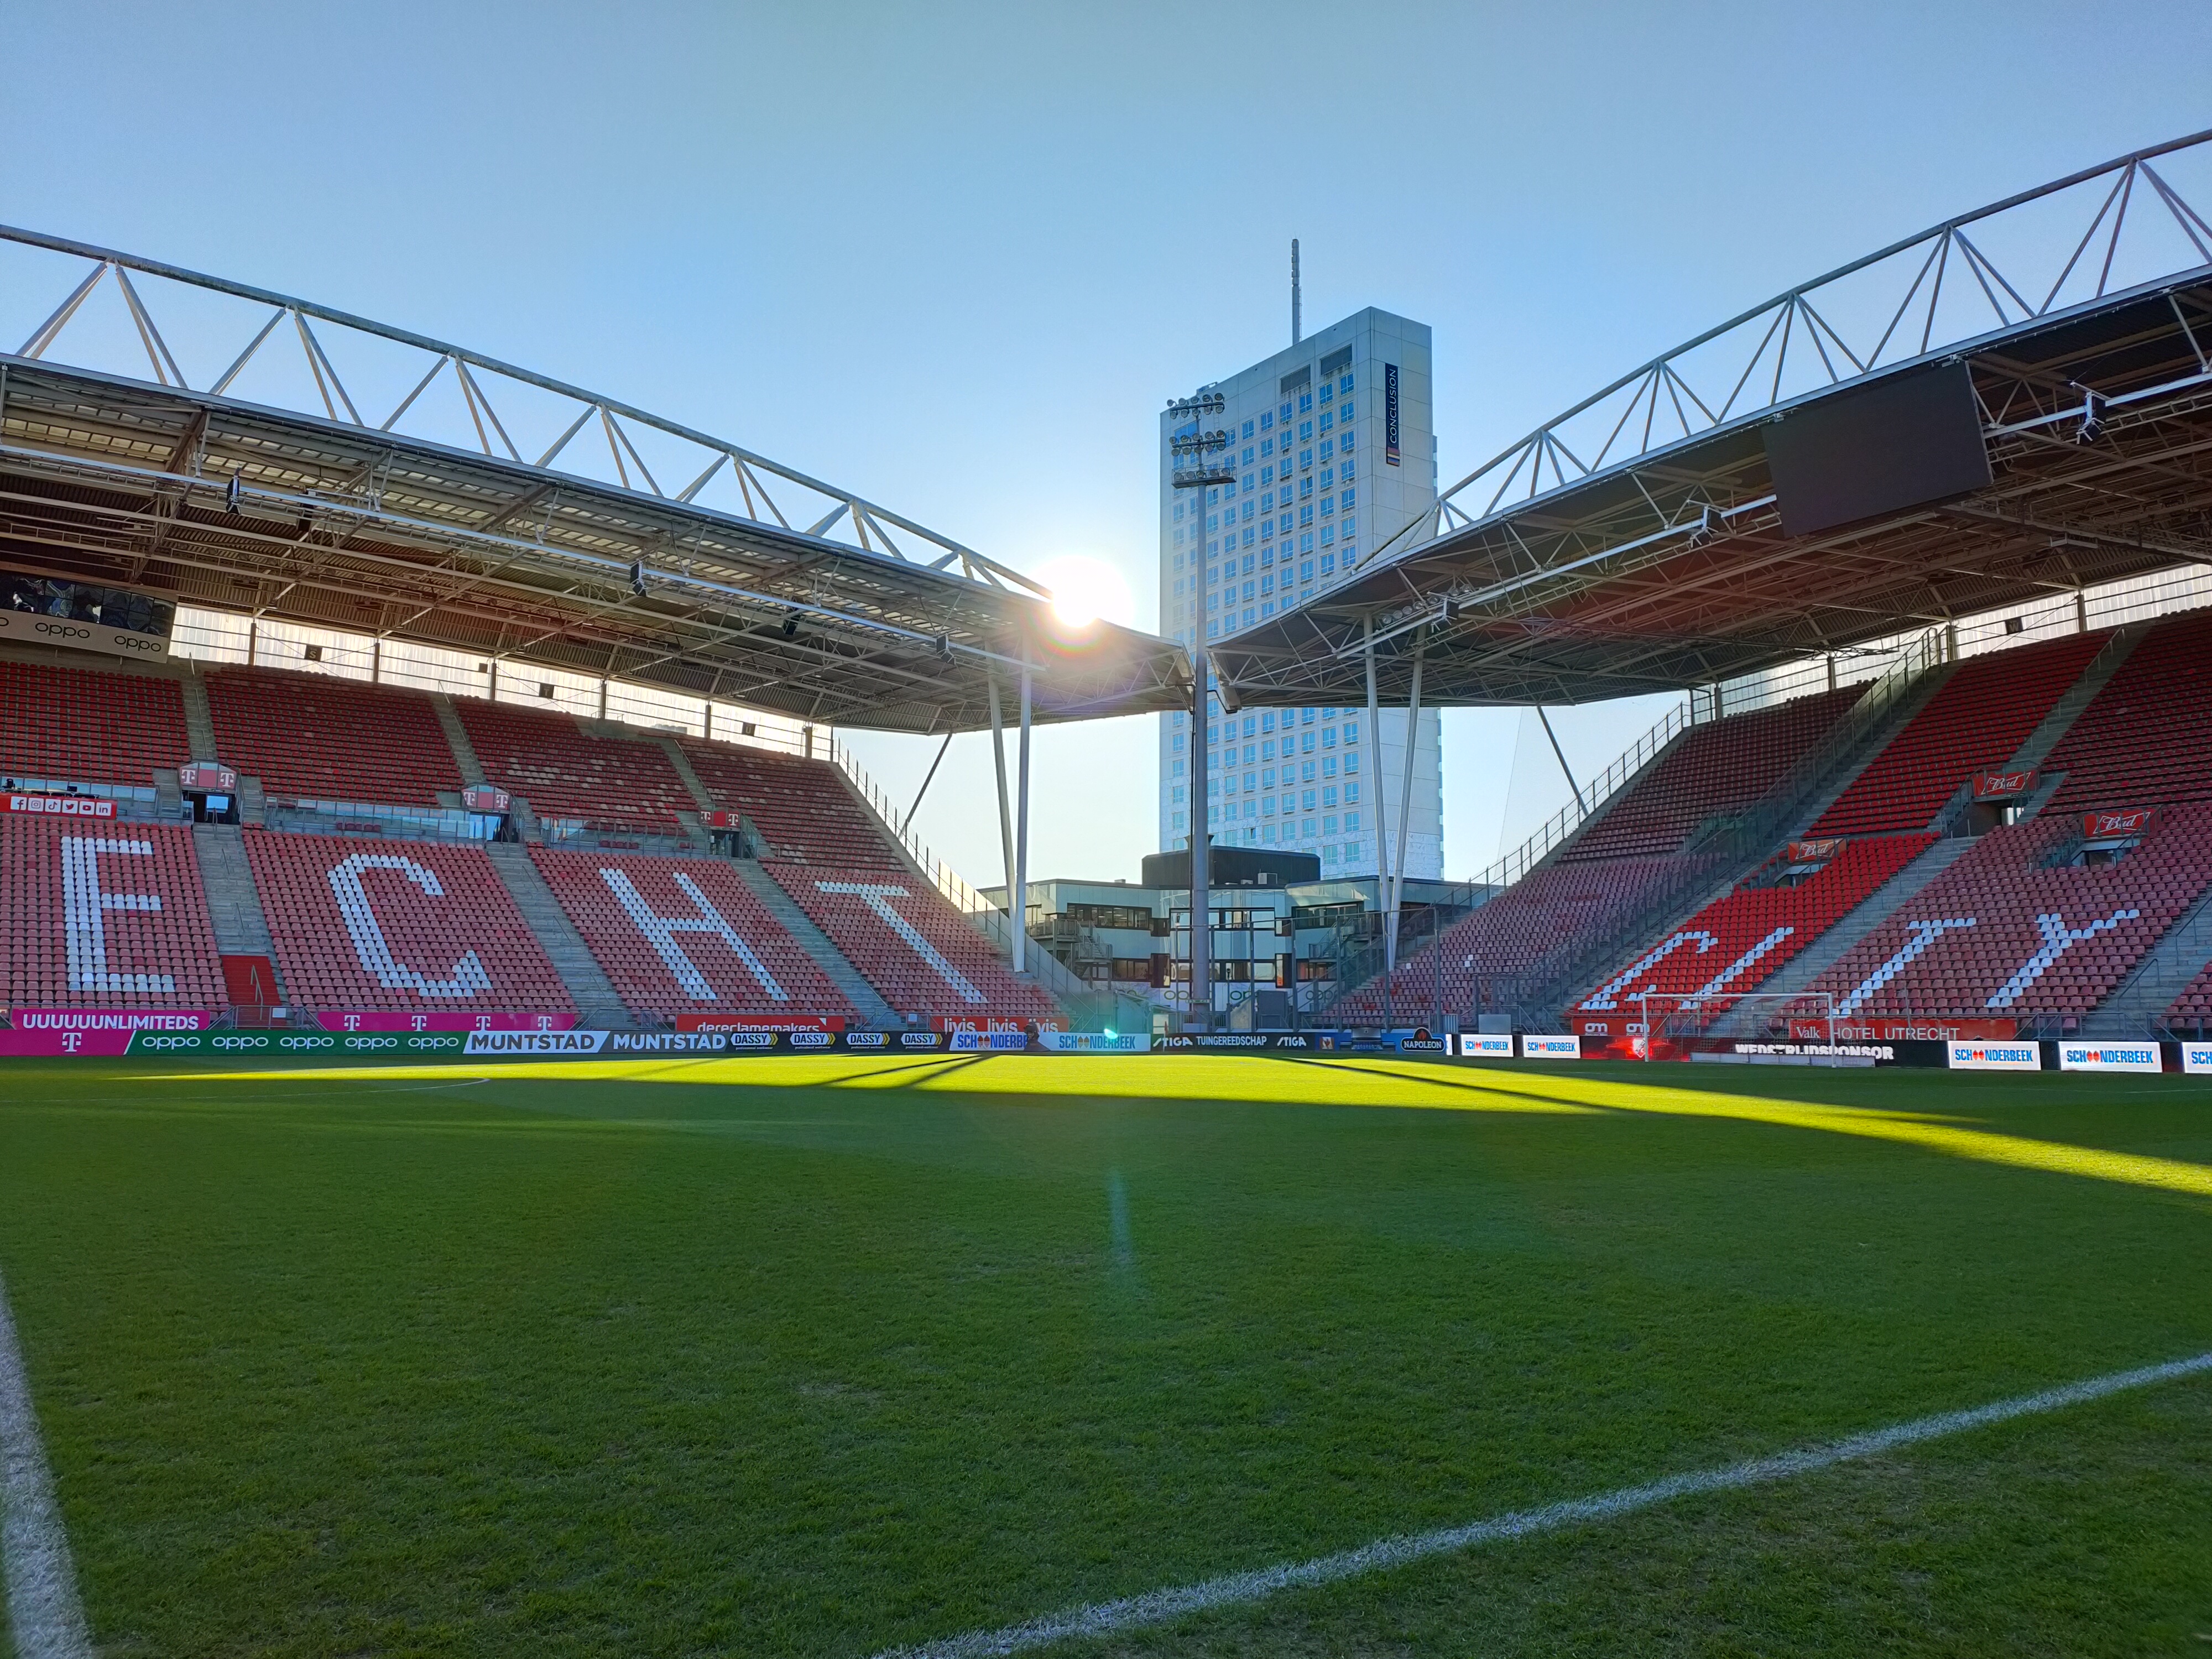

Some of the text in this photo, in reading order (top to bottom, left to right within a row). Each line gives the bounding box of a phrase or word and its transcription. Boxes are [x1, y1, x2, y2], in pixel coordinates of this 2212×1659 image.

[35, 622, 90, 639] oppo
[114, 635, 161, 652] oppo
[309, 650, 316, 659] S
[1990, 777, 2018, 790] Bud
[2103, 816, 2136, 829] Bud
[23, 1014, 199, 1030] UUUUUUNLIMITEDS
[735, 1035, 768, 1044] DASSY
[794, 1035, 826, 1044] DASSY
[851, 1035, 880, 1044] DASSY
[905, 1035, 933, 1044] DASSY
[1796, 1026, 1960, 1040] Valk HOTEL UTRECHT
[142, 1036, 459, 1050] oppo oppo oppo oppo oppo
[471, 1034, 594, 1050] MUNTSTAD
[614, 1034, 726, 1050] MUNTSTAD
[1153, 1035, 1307, 1047] STIGA TUINGEREEDSCHAP STIGA
[1404, 1040, 1442, 1049] NAPOLEON
